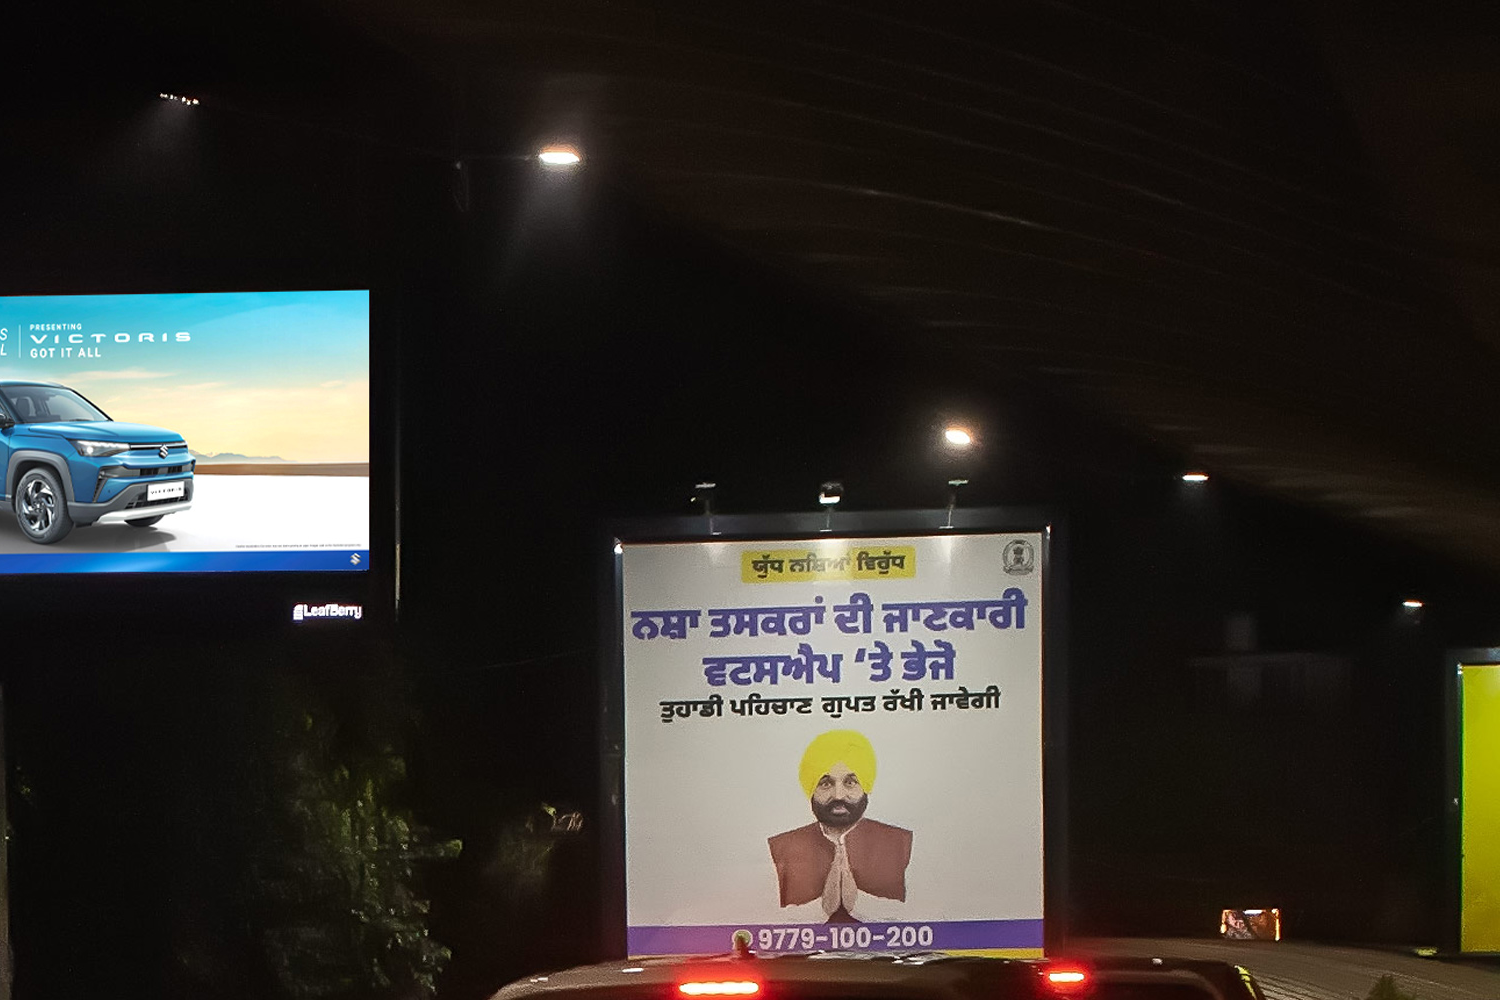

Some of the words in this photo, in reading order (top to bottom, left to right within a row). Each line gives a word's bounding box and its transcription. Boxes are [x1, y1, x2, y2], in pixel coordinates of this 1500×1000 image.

[29, 323, 82, 331] PRESENTING
[30, 332, 191, 344] VICTORIS
[30, 348, 55, 358] GOT
[61, 348, 72, 358] IT
[78, 347, 102, 358] ALL
[303, 603, 362, 619] LeafBerry
[631, 610, 701, 640] ਨਸ਼ਾ
[708, 595, 826, 638] ਤਸਕਰਾਂ
[833, 592, 873, 634] ਦੀ
[882, 587, 1028, 633] ਜਾਣਕਾਰੀ
[702, 643, 843, 686] ਵਟਸਐਪ
[901, 639, 956, 681] ਭੇਜੋ
[659, 694, 724, 723] ਤੁਹਾਡੀ
[730, 693, 813, 716] ਪਹਿਚਾਣ
[821, 696, 876, 718] ਗੁਪਤ
[882, 688, 924, 712] ਰੱਖੀ
[930, 685, 1001, 711] ਜਾਵੇਗੀ
[758, 925, 934, 950] 9779-100-200
